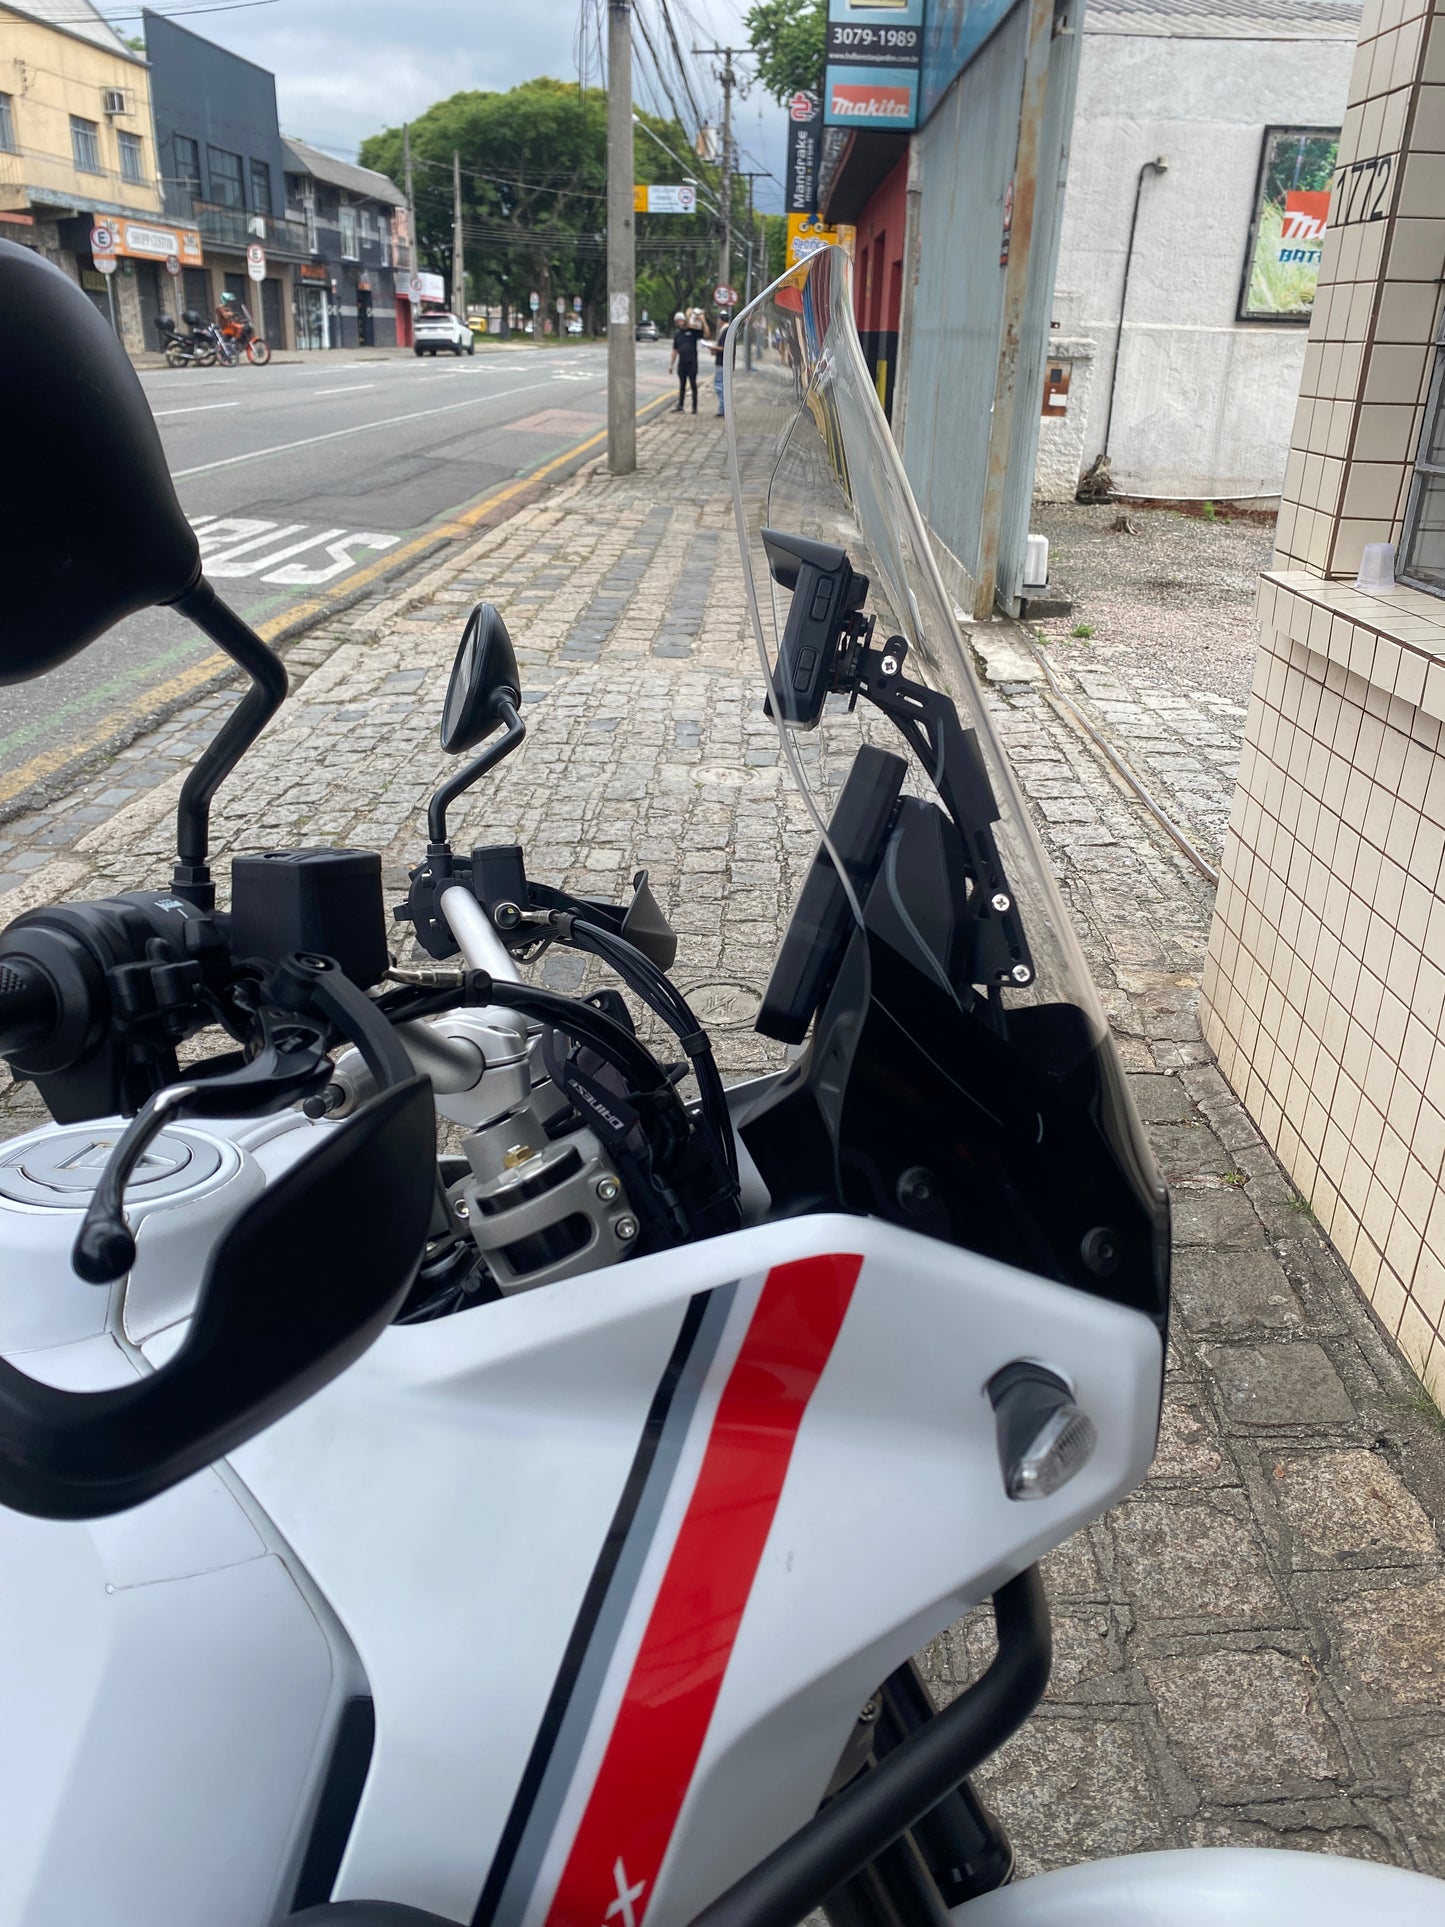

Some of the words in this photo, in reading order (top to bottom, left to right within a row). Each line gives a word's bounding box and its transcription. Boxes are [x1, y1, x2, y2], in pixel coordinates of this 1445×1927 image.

[832, 27, 917, 47] 3079-1989
[793, 130, 808, 208] Mandrake
[1334, 157, 1392, 226] 1772
[98, 231, 107, 245] E
[716, 289, 729, 299] 50
[567, 1078, 625, 1130] DAINESE
